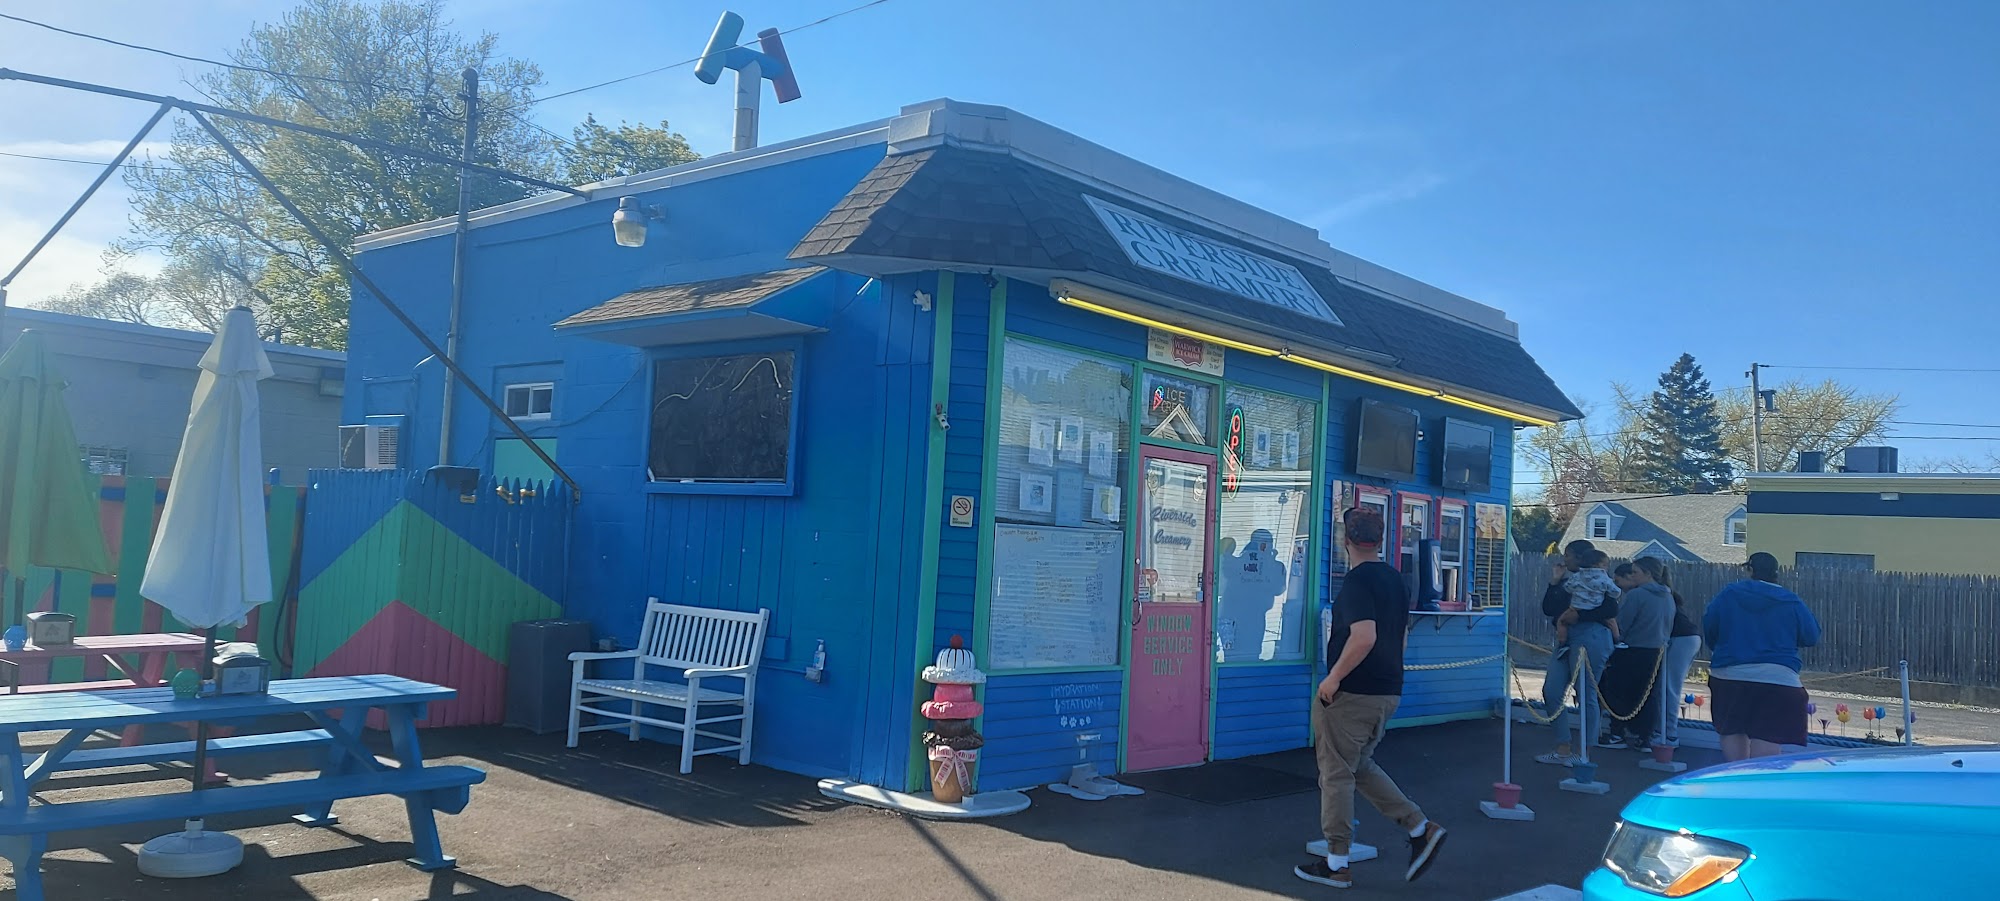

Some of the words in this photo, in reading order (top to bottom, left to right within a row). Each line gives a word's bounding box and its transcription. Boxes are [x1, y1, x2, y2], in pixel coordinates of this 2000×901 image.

[1103, 208, 1303, 291] RIVERSIDE
[1131, 240, 1323, 316] CREAMERY
[1174, 340, 1201, 353] WARWICK
[1167, 387, 1186, 403] ICE
[1151, 505, 1197, 528] Riverside
[1153, 529, 1192, 550] Creamery
[1147, 614, 1192, 633] WINDOW
[1143, 636, 1193, 654] SERVICE
[1152, 658, 1184, 676] ONLY
[1054, 684, 1099, 697] HYDRATION
[1060, 698, 1096, 710] STATION
